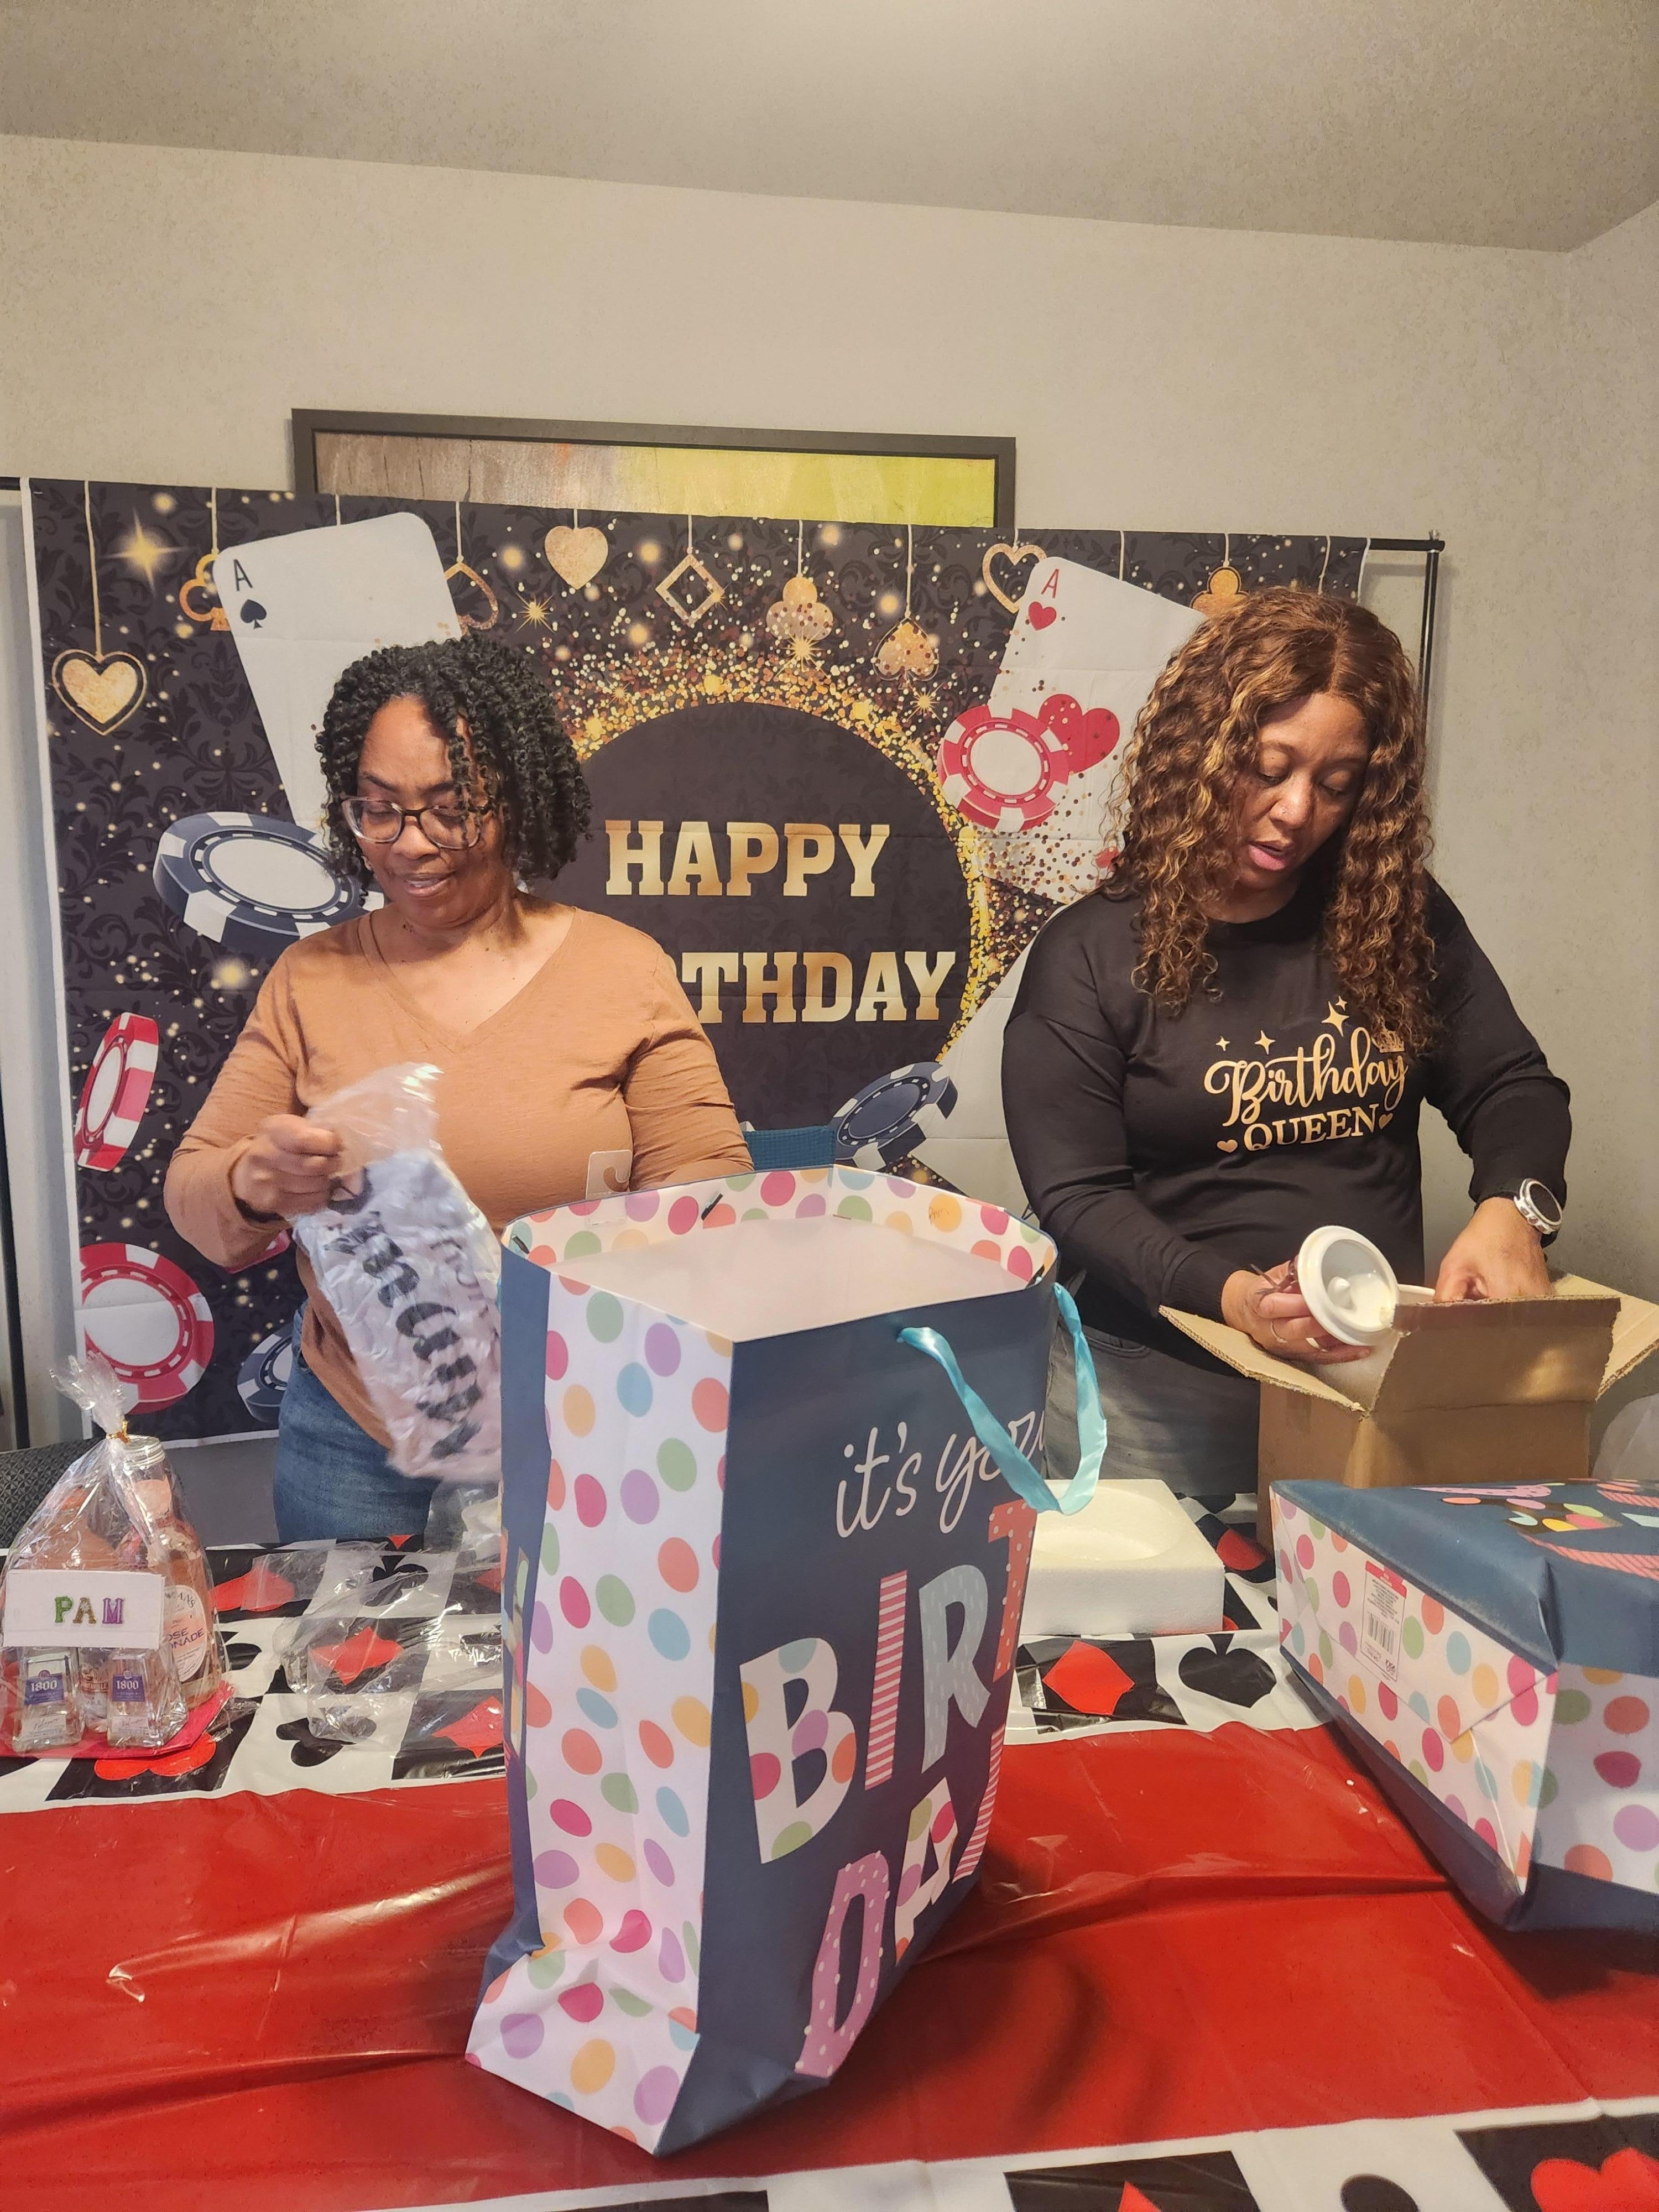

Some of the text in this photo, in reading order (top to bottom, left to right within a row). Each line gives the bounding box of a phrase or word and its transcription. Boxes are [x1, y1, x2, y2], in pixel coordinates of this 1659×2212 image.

[233, 559, 253, 592] A
[1041, 568, 1060, 599] A
[605, 820, 890, 897] HAPPY
[672, 951, 956, 1023] THDAY
[1204, 1027, 1409, 1126] Birthday
[1244, 1103, 1379, 1152] QUEEN
[836, 1422, 921, 1538] it's
[54, 1595, 124, 1624] PAM
[31, 1679, 57, 1692] 1800
[117, 1679, 139, 1691] 1800
[739, 1498, 1038, 1864] BIRT
[794, 1723, 1006, 2079] DA
